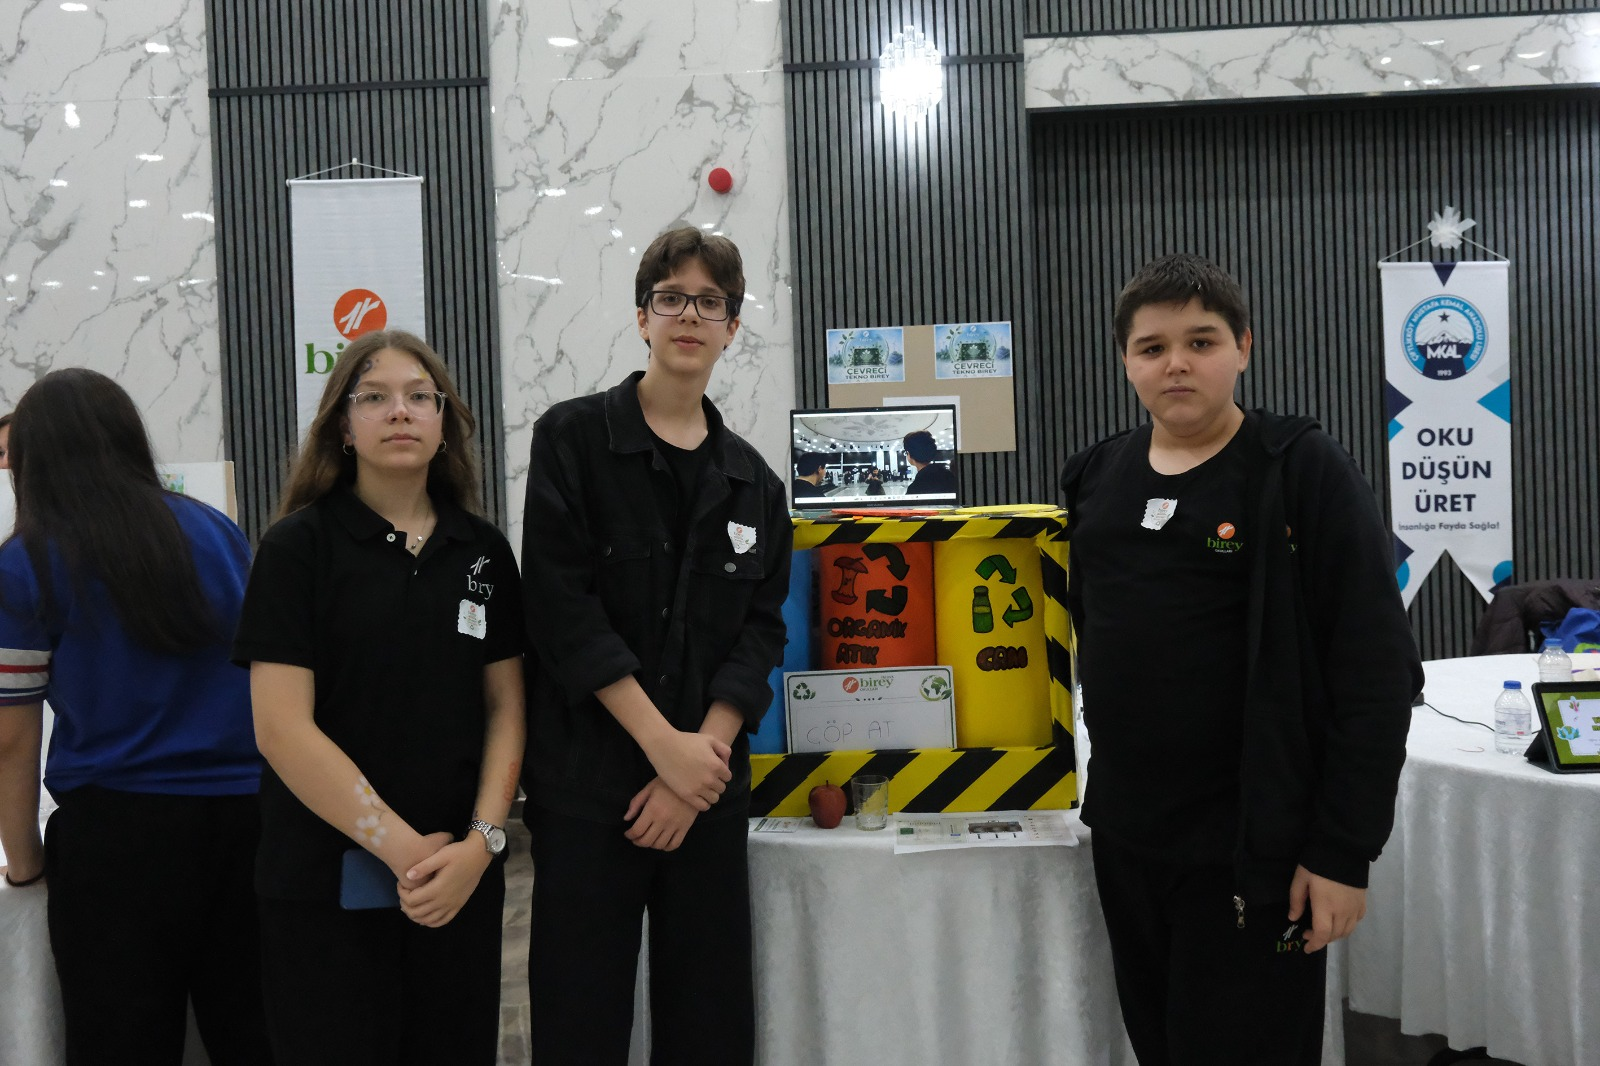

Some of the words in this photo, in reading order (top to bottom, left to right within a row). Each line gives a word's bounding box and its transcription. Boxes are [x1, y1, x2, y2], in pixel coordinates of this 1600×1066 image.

[1426, 344, 1462, 359] MKAL
[1417, 427, 1473, 447] OKU
[1402, 455, 1491, 485] DÜŞÜN
[1415, 489, 1476, 513] ÜRET
[1439, 521, 1466, 532] Fayda
[1207, 537, 1244, 552] birey
[467, 575, 494, 600] bry
[860, 678, 894, 688] birey
[868, 720, 895, 739] AT
